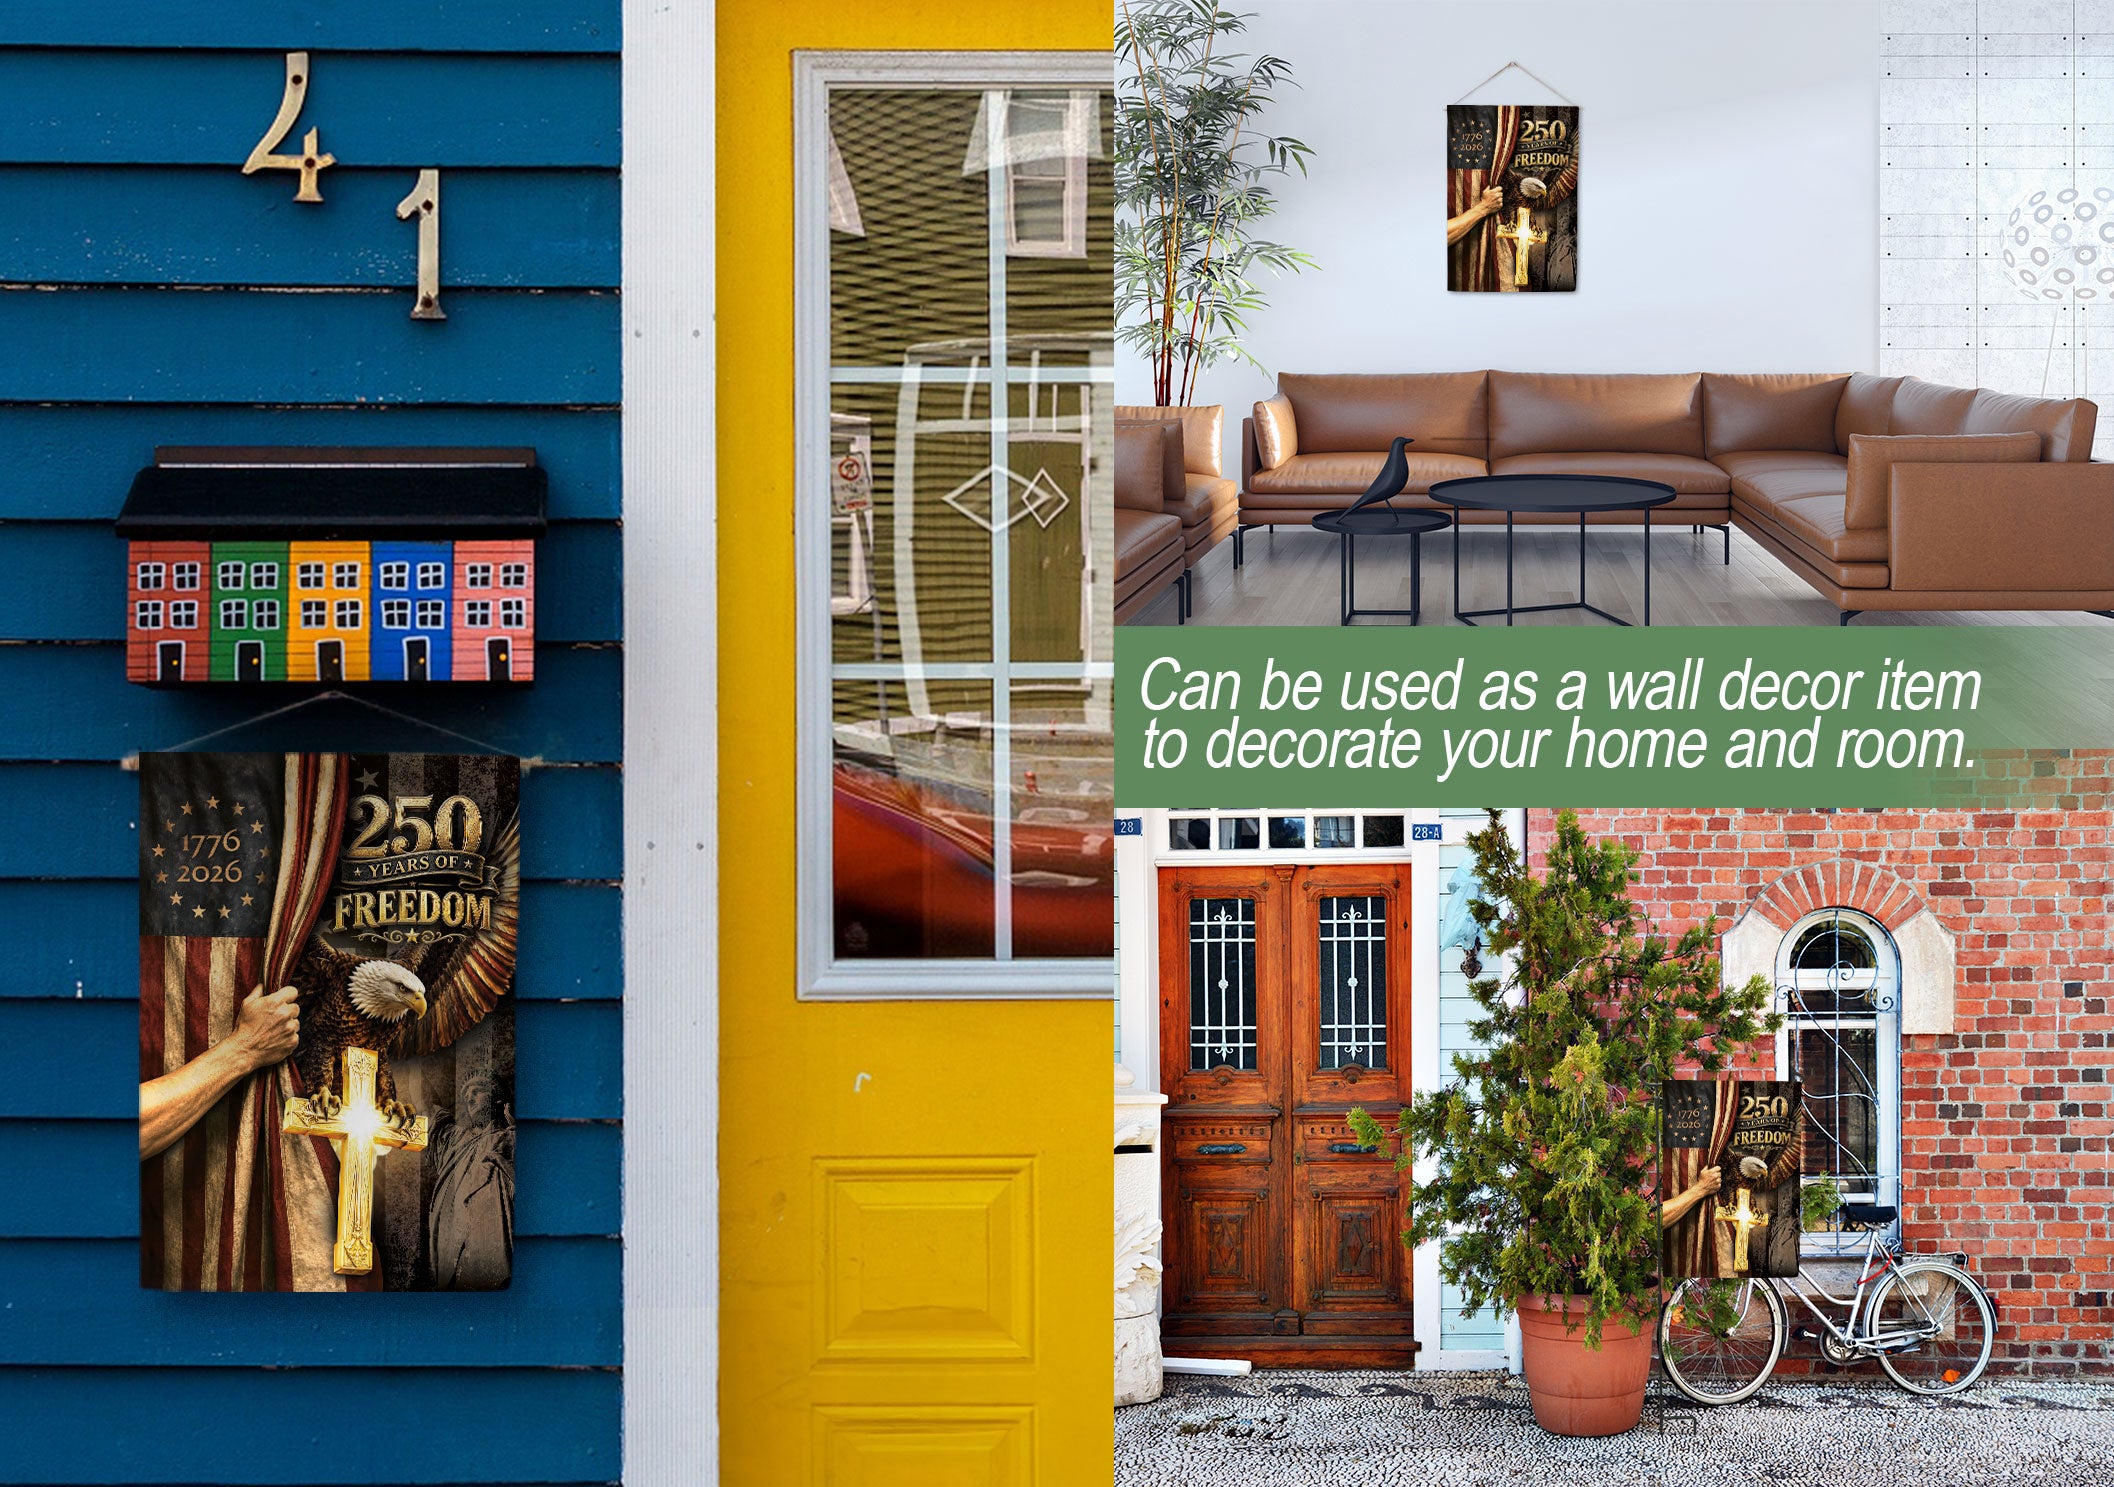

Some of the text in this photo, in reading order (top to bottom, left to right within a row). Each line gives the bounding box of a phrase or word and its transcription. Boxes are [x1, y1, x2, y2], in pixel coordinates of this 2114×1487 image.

[1462, 131, 1483, 142] 1776
[1521, 120, 1566, 143] 250
[1460, 143, 1484, 151] 2026
[1514, 152, 1569, 168] FREEDOM
[352, 794, 483, 859] 250
[1120, 821, 1134, 833] 28
[1414, 827, 1440, 839] 28-A
[181, 829, 241, 860] 1776
[176, 860, 243, 883] 2026
[367, 855, 460, 879] YEARS OF
[333, 889, 493, 932] FREEDOM
[1678, 1109, 1700, 1119] 1776
[1740, 1095, 1789, 1119] 250
[1676, 1120, 1701, 1129] 2026
[1733, 1130, 1792, 1146] FREEDOM
